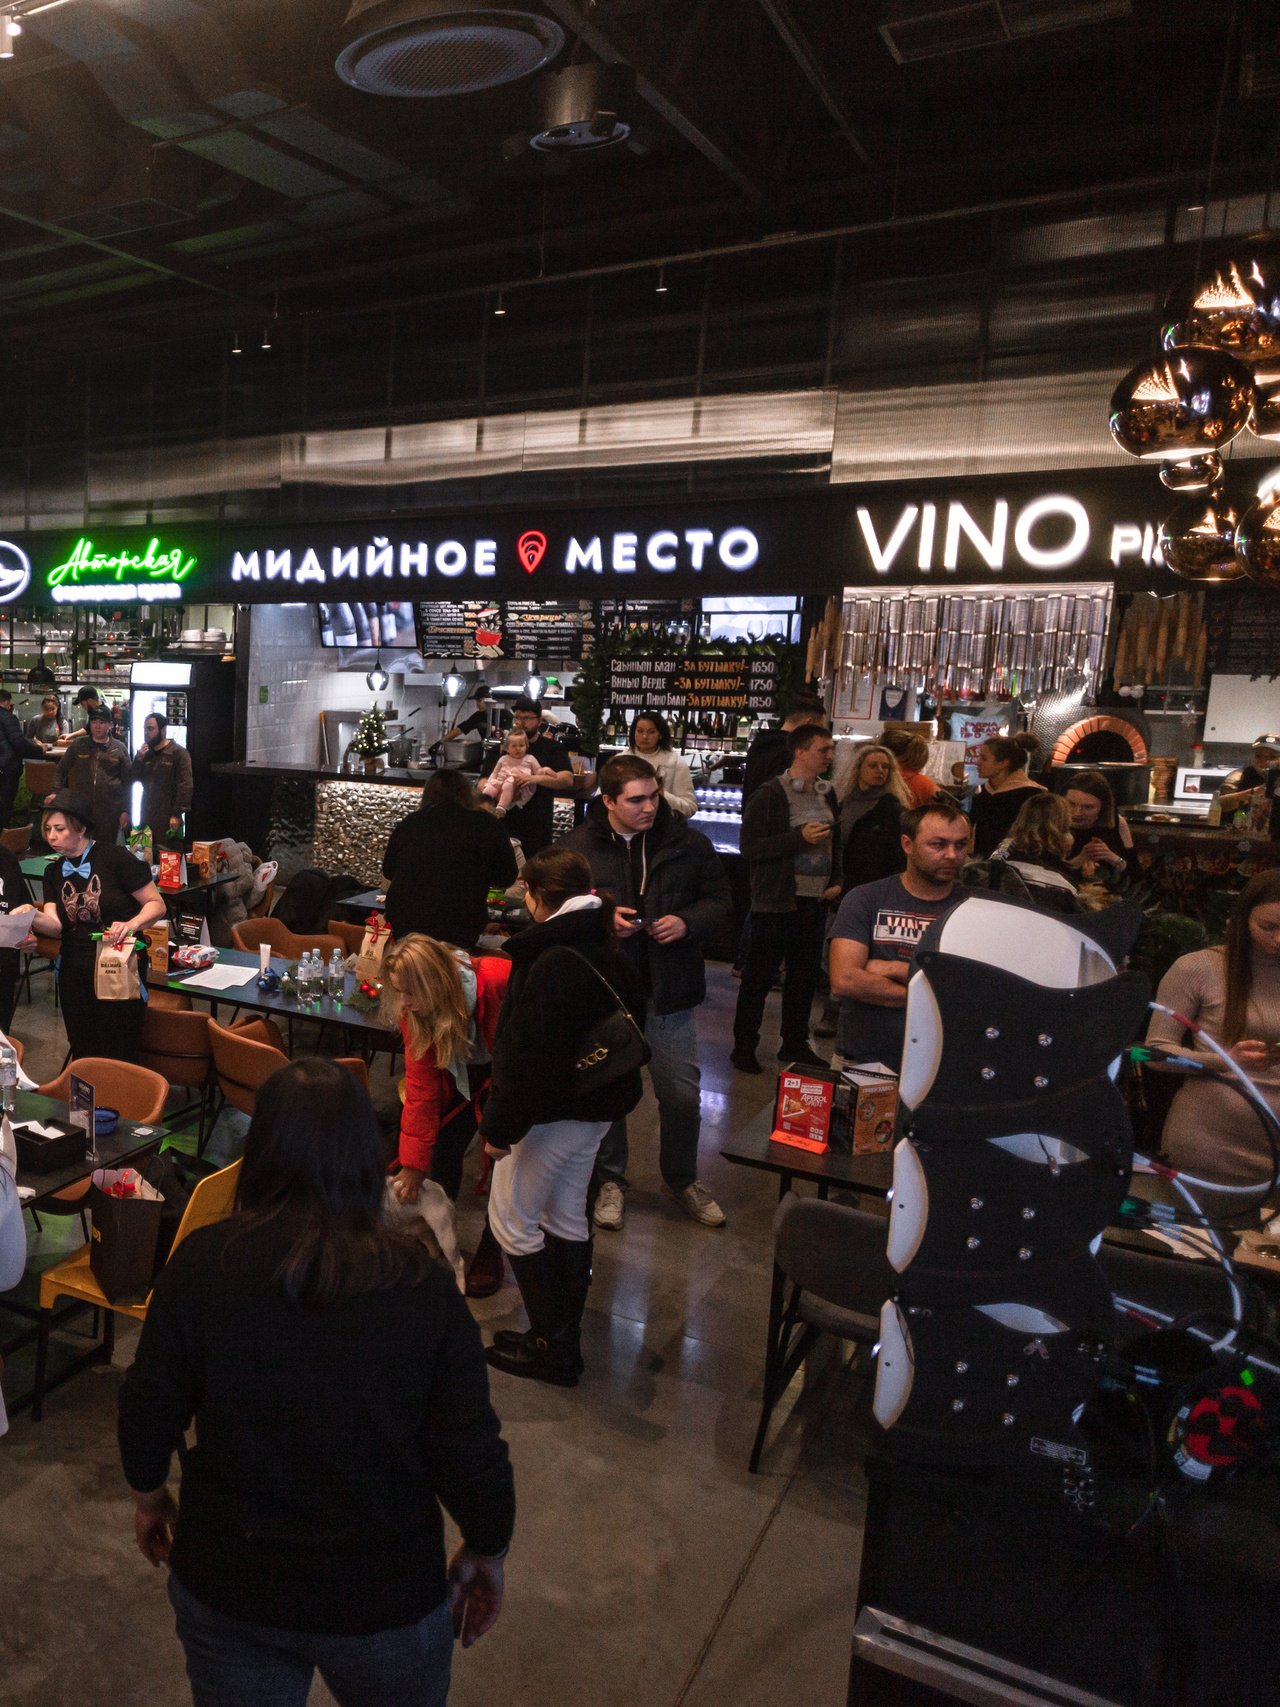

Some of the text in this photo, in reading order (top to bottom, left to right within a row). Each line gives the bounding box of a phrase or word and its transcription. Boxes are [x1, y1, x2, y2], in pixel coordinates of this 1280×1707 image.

[857, 497, 1090, 571] VINO
[232, 526, 759, 582] МИДИЙНОЕ МЕСТО
[49, 537, 197, 585] Авторская
[751, 661, 774, 673] 1650
[750, 678, 773, 690] 1750
[749, 695, 772, 707] 1850
[800, 1093, 828, 1104] APEROL
